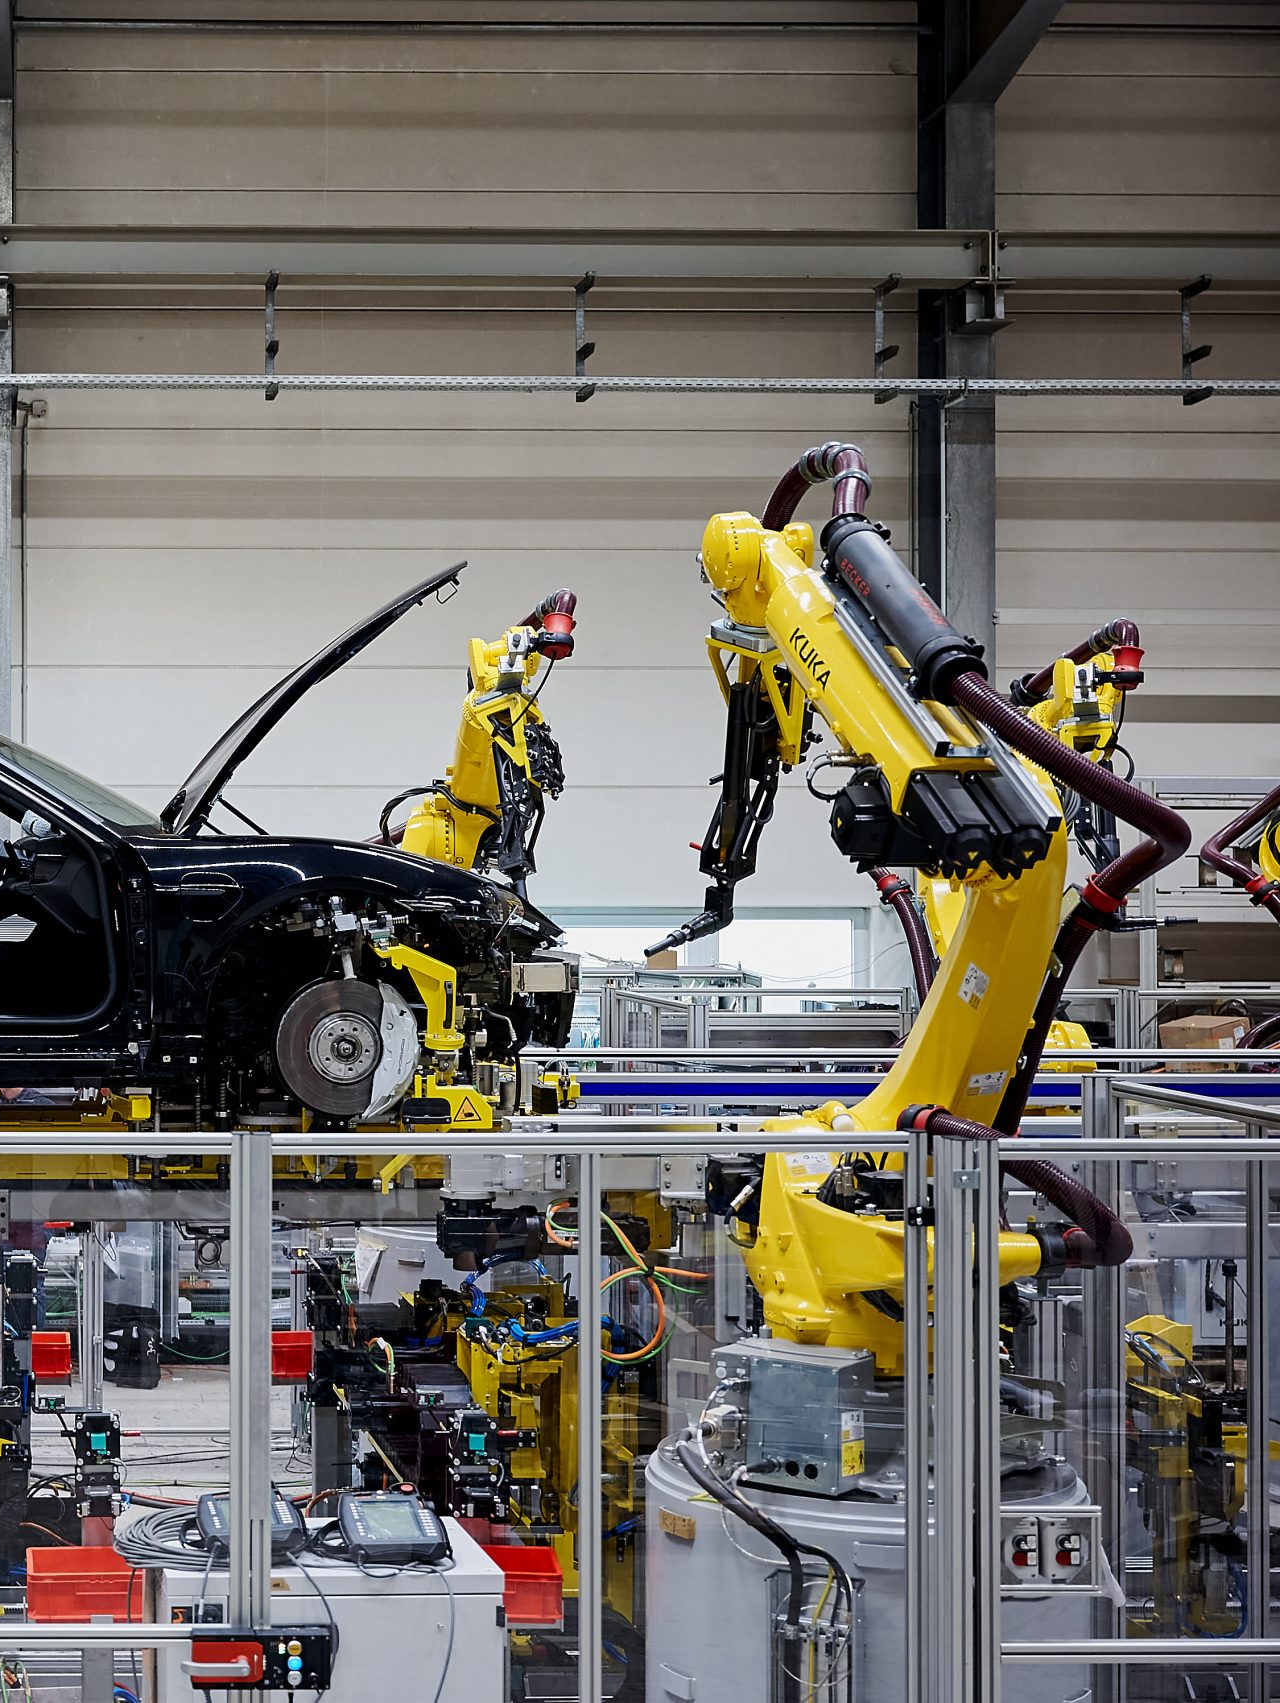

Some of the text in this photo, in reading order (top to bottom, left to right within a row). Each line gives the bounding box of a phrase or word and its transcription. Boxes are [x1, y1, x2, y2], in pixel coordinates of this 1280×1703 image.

[839, 558, 871, 598] BECKER
[789, 627, 831, 691] KUKA
[1219, 1318, 1248, 1328] KUK
